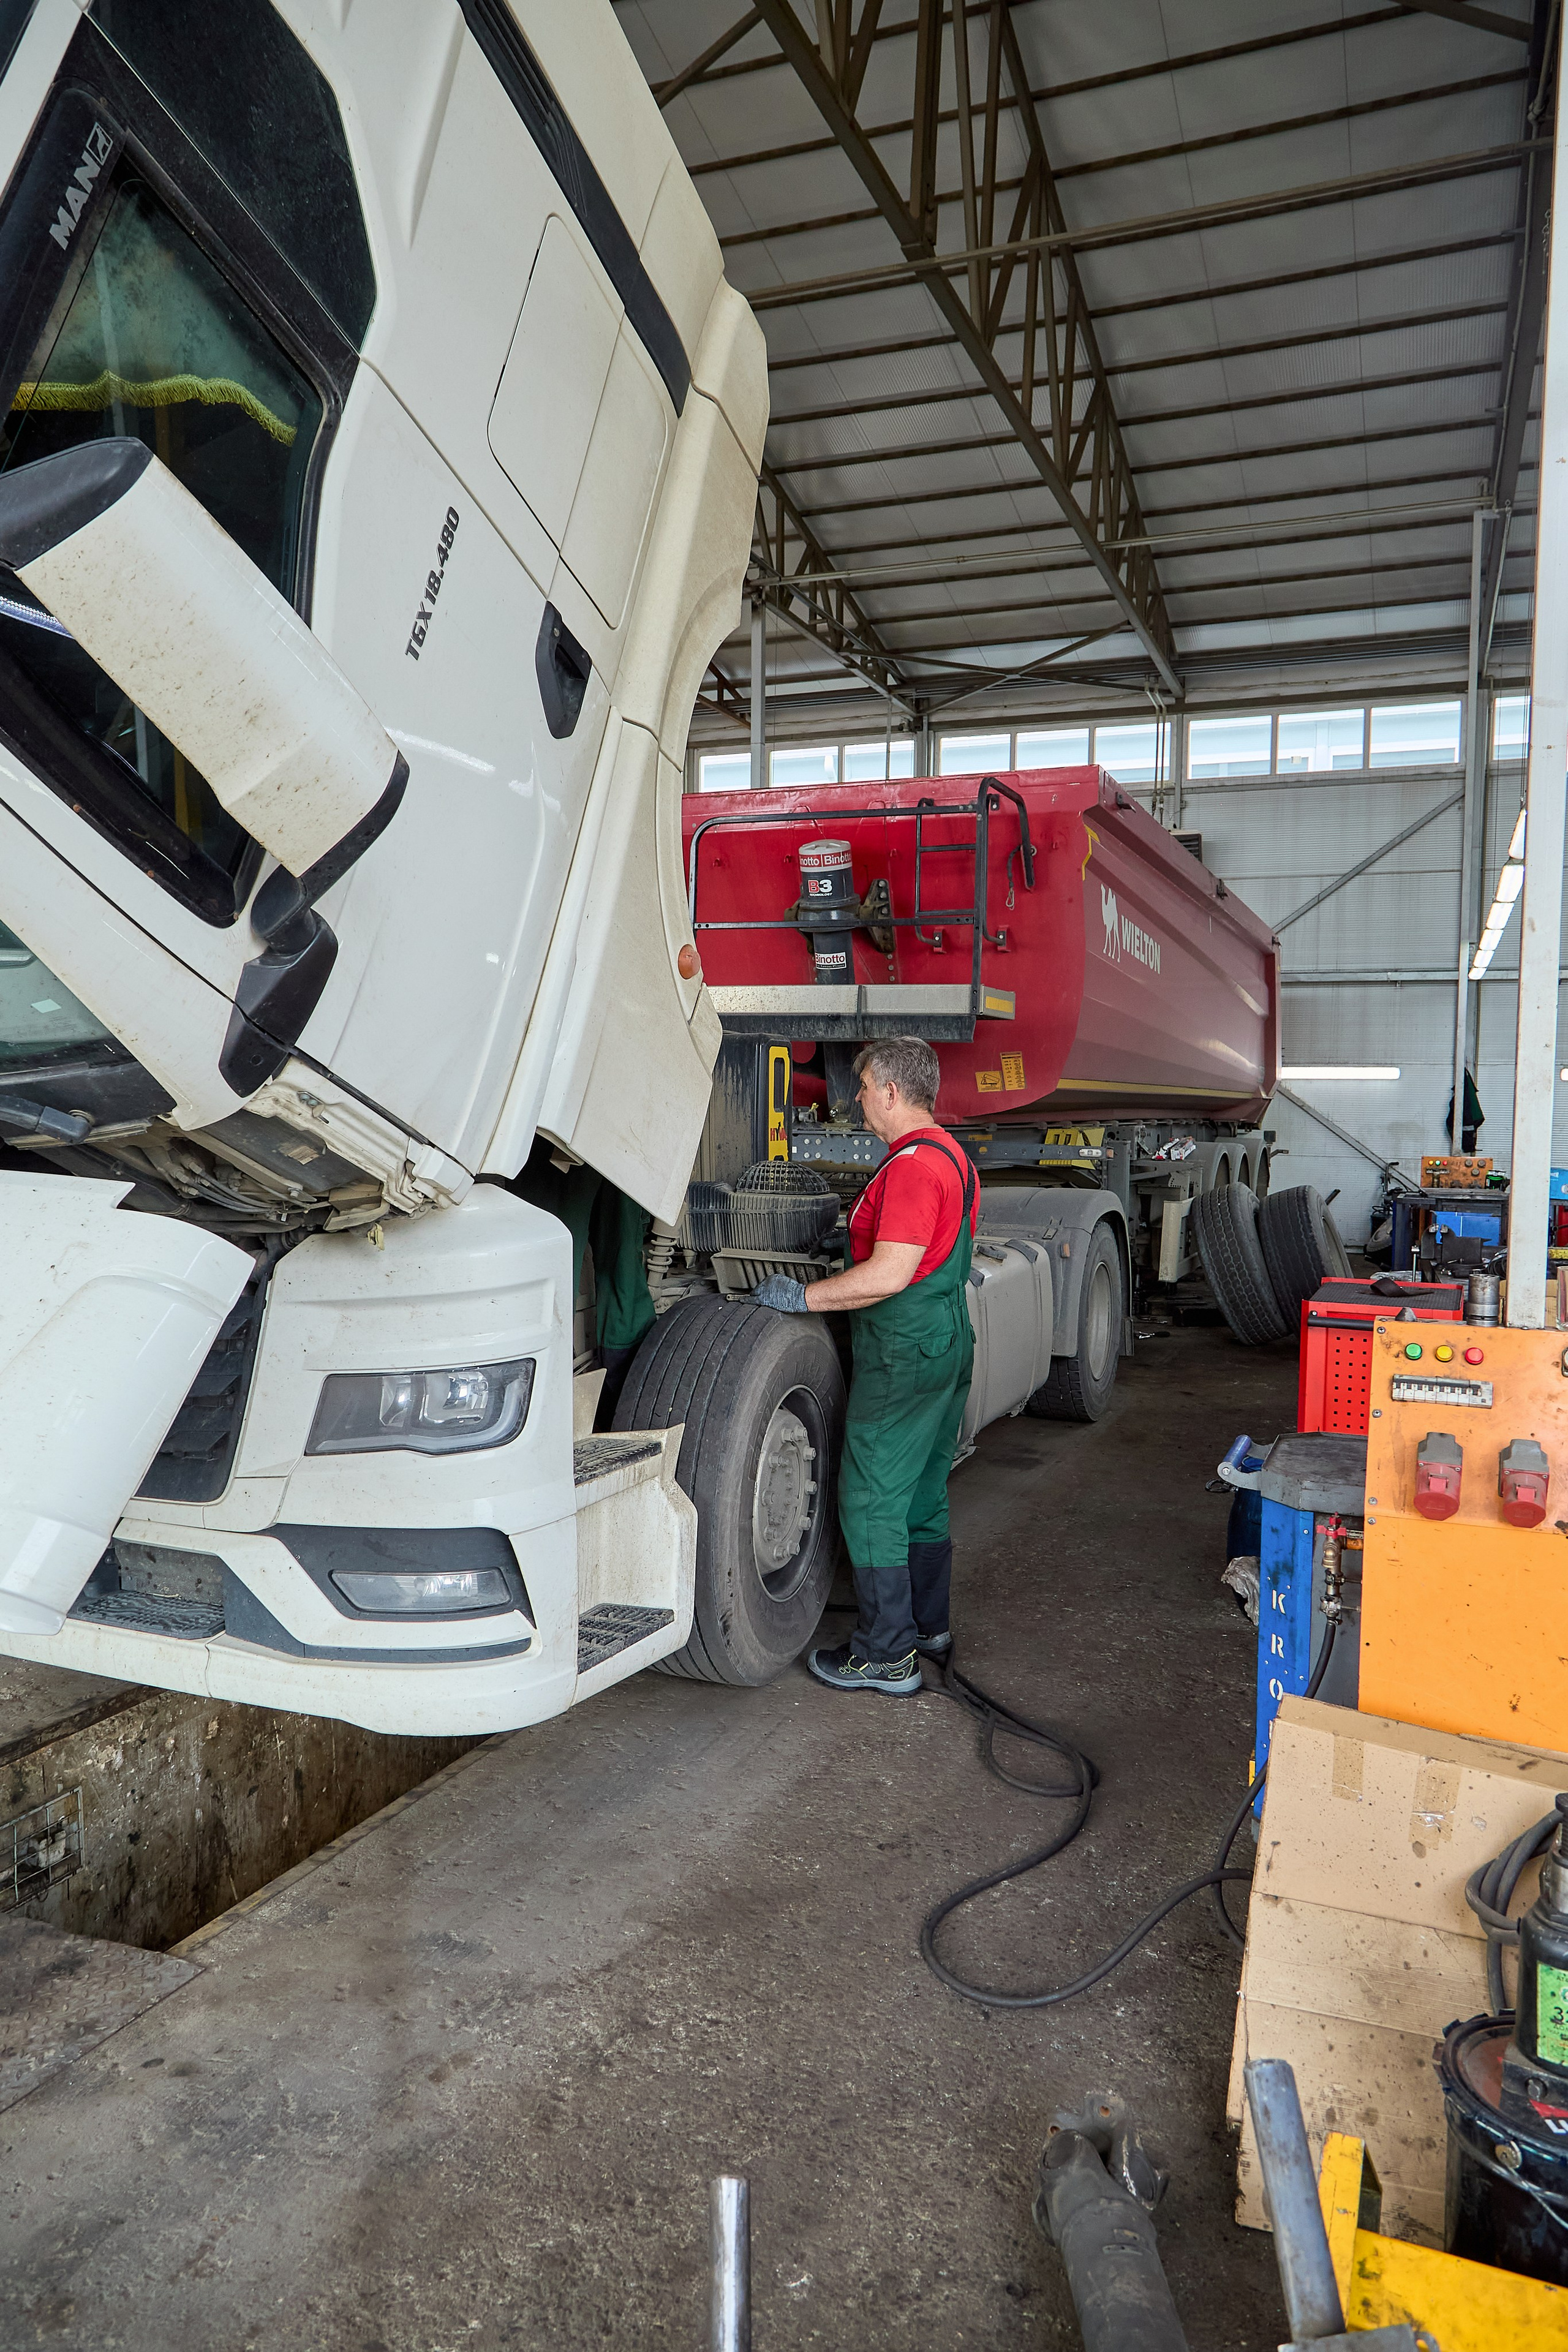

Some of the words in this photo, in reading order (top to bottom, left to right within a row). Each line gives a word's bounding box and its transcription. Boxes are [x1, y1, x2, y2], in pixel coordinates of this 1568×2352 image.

[49, 151, 100, 251] MAN
[405, 601, 432, 661] TGX
[424, 506, 459, 605] 18.480
[799, 856, 820, 865] inotto
[808, 879, 832, 893] B3
[815, 954, 845, 963] Binotto
[1121, 914, 1161, 974] WIELTON
